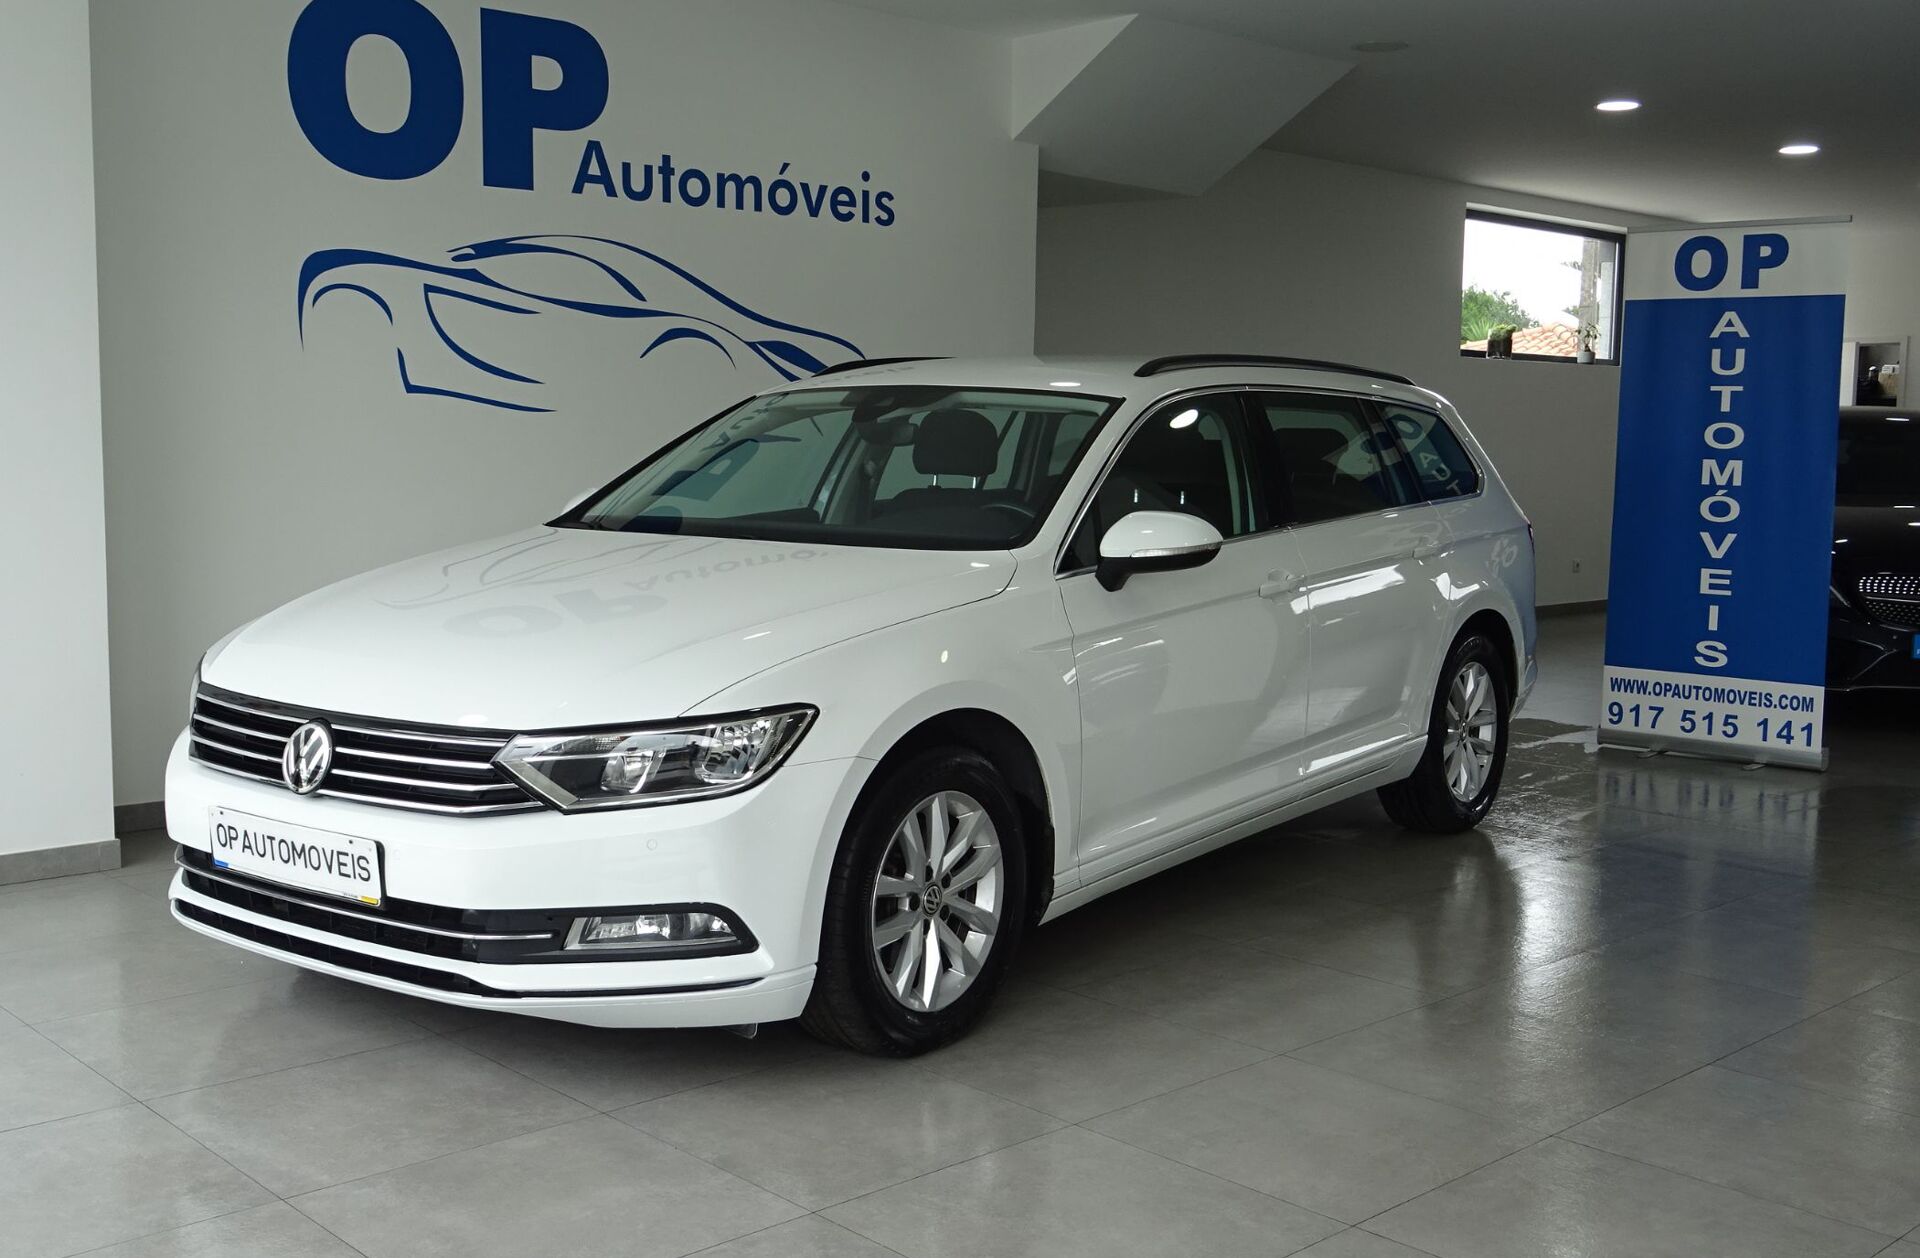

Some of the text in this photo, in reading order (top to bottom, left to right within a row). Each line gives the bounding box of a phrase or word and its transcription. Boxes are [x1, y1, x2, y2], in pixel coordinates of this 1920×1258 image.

[288, 0, 609, 191] OP
[572, 140, 895, 227] Automóveis
[1674, 233, 1789, 292] OP
[1694, 311, 1750, 668] AUTOMÓVEIS
[1607, 701, 1814, 747] 917 515 141
[1610, 676, 1814, 713] WWW.OPAUTOMOVEIS.COM
